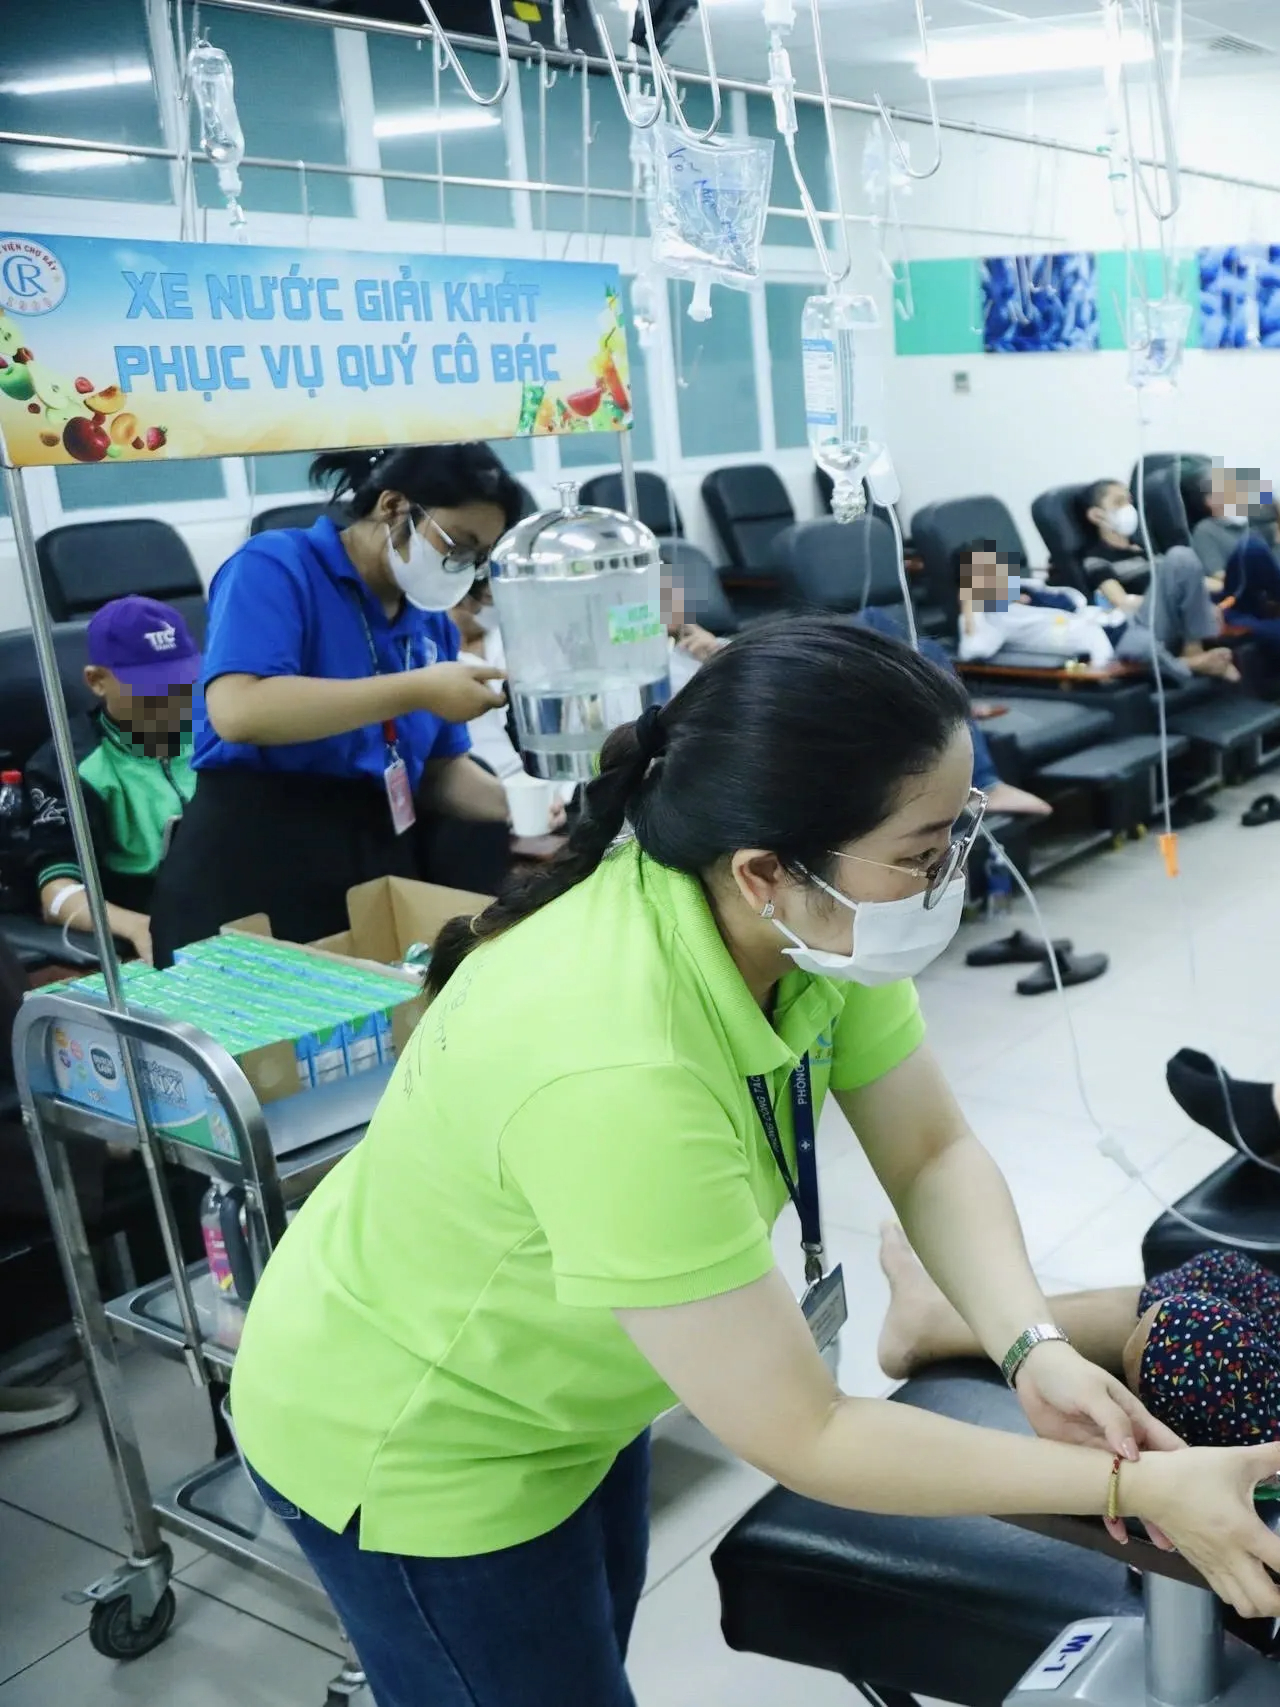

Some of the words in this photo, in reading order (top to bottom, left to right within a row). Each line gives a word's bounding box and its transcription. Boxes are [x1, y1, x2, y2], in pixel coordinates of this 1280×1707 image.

[120, 270, 194, 320] XE
[205, 263, 344, 321] NƯỚC
[354, 265, 433, 321] GIẢI
[443, 271, 540, 322] KHÁT
[113, 345, 250, 401] PHỤC
[260, 344, 325, 398] VỤ
[336, 331, 418, 392] QUÝ
[432, 331, 480, 384] CÔ
[490, 331, 561, 383] BÁC
